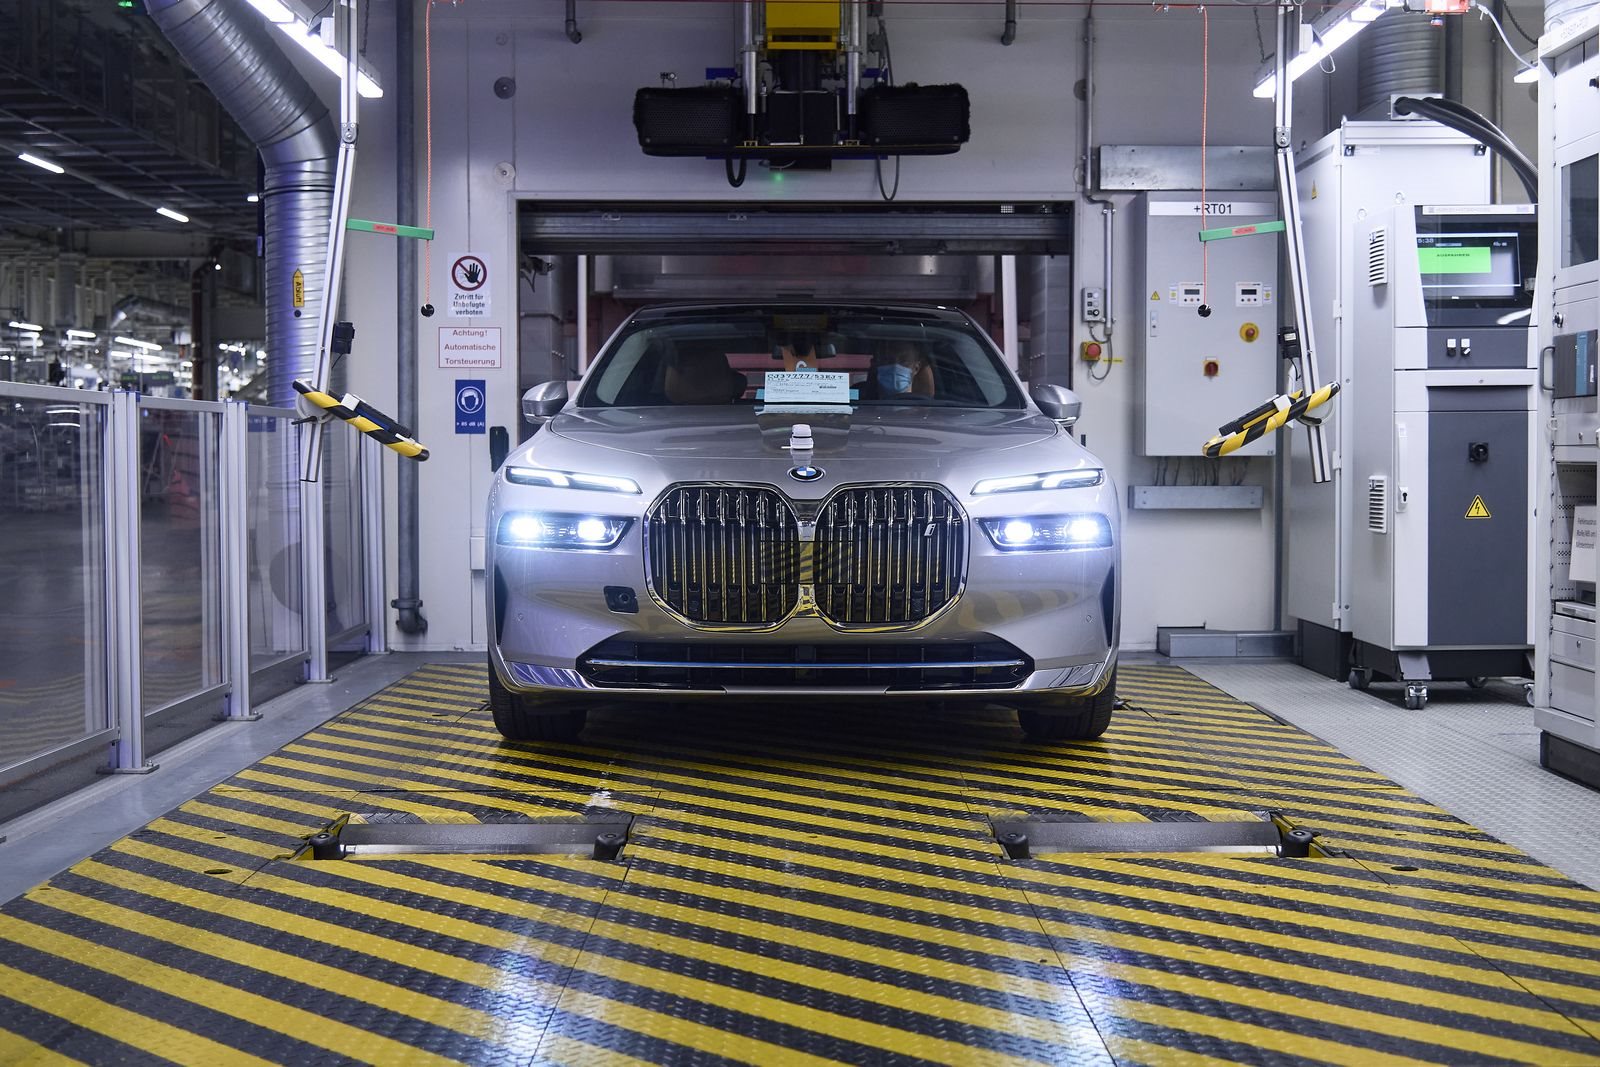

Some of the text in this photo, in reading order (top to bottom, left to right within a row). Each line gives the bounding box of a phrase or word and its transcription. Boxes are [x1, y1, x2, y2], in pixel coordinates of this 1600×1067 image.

[1194, 203, 1232, 214] +RT01
[453, 301, 485, 309] Unbefugte
[452, 329, 488, 338] Achtung!
[444, 343, 496, 351] Automatische
[445, 357, 496, 366] Torsteuerung
